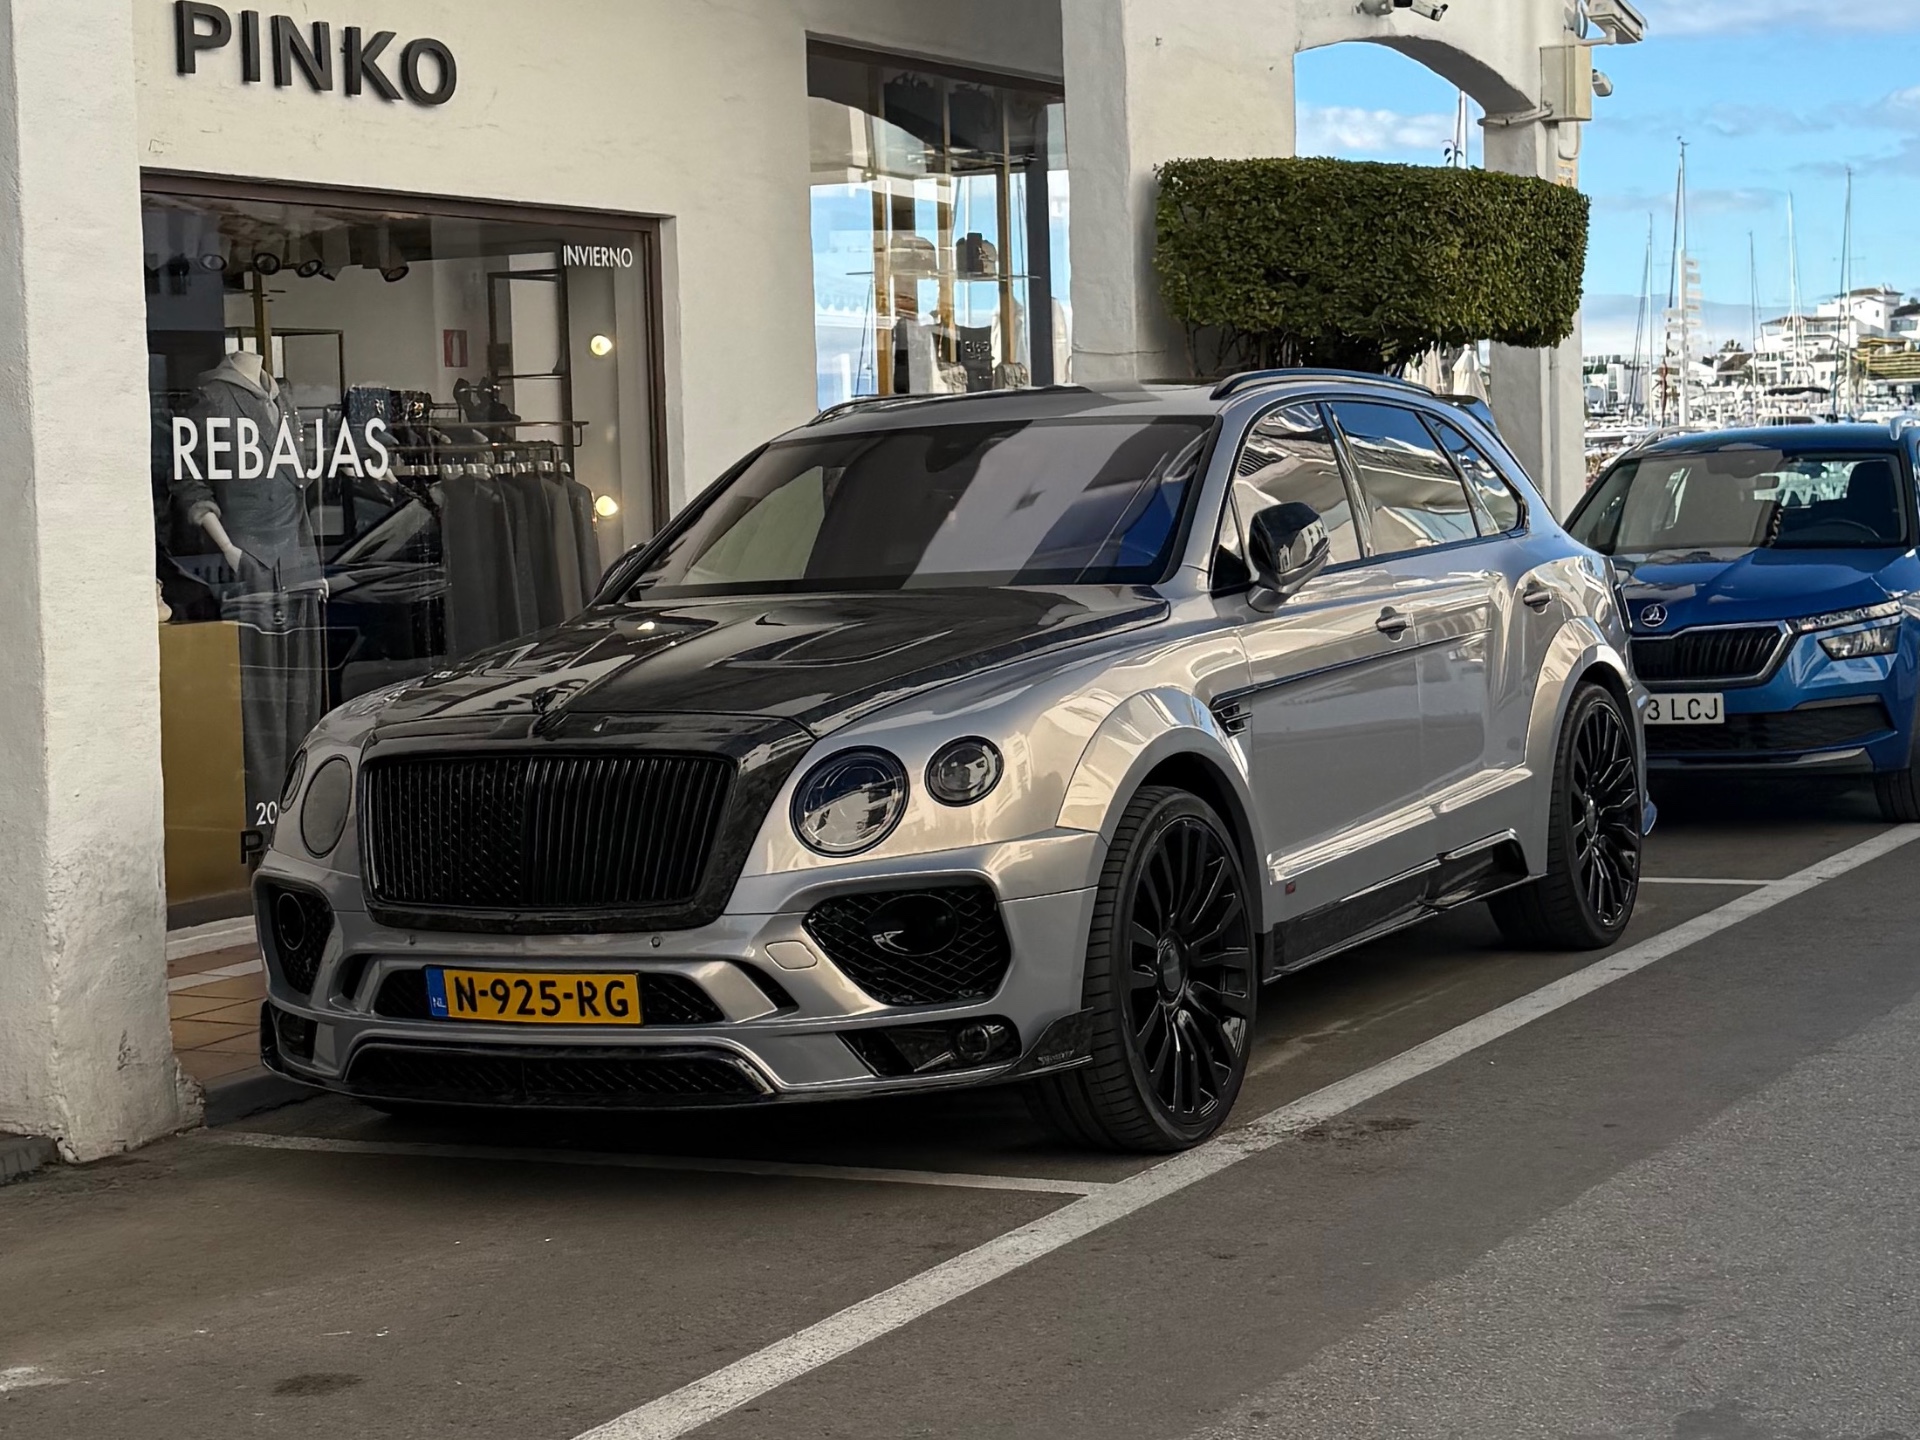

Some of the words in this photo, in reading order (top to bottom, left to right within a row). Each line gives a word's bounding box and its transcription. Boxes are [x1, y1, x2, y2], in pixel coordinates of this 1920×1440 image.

[176, 0, 457, 105] PINKO
[563, 244, 633, 268] INVIERNO
[172, 417, 390, 481] REBAJAS
[1671, 697, 1718, 721] LCJ
[454, 976, 629, 1017] N-925-RG
